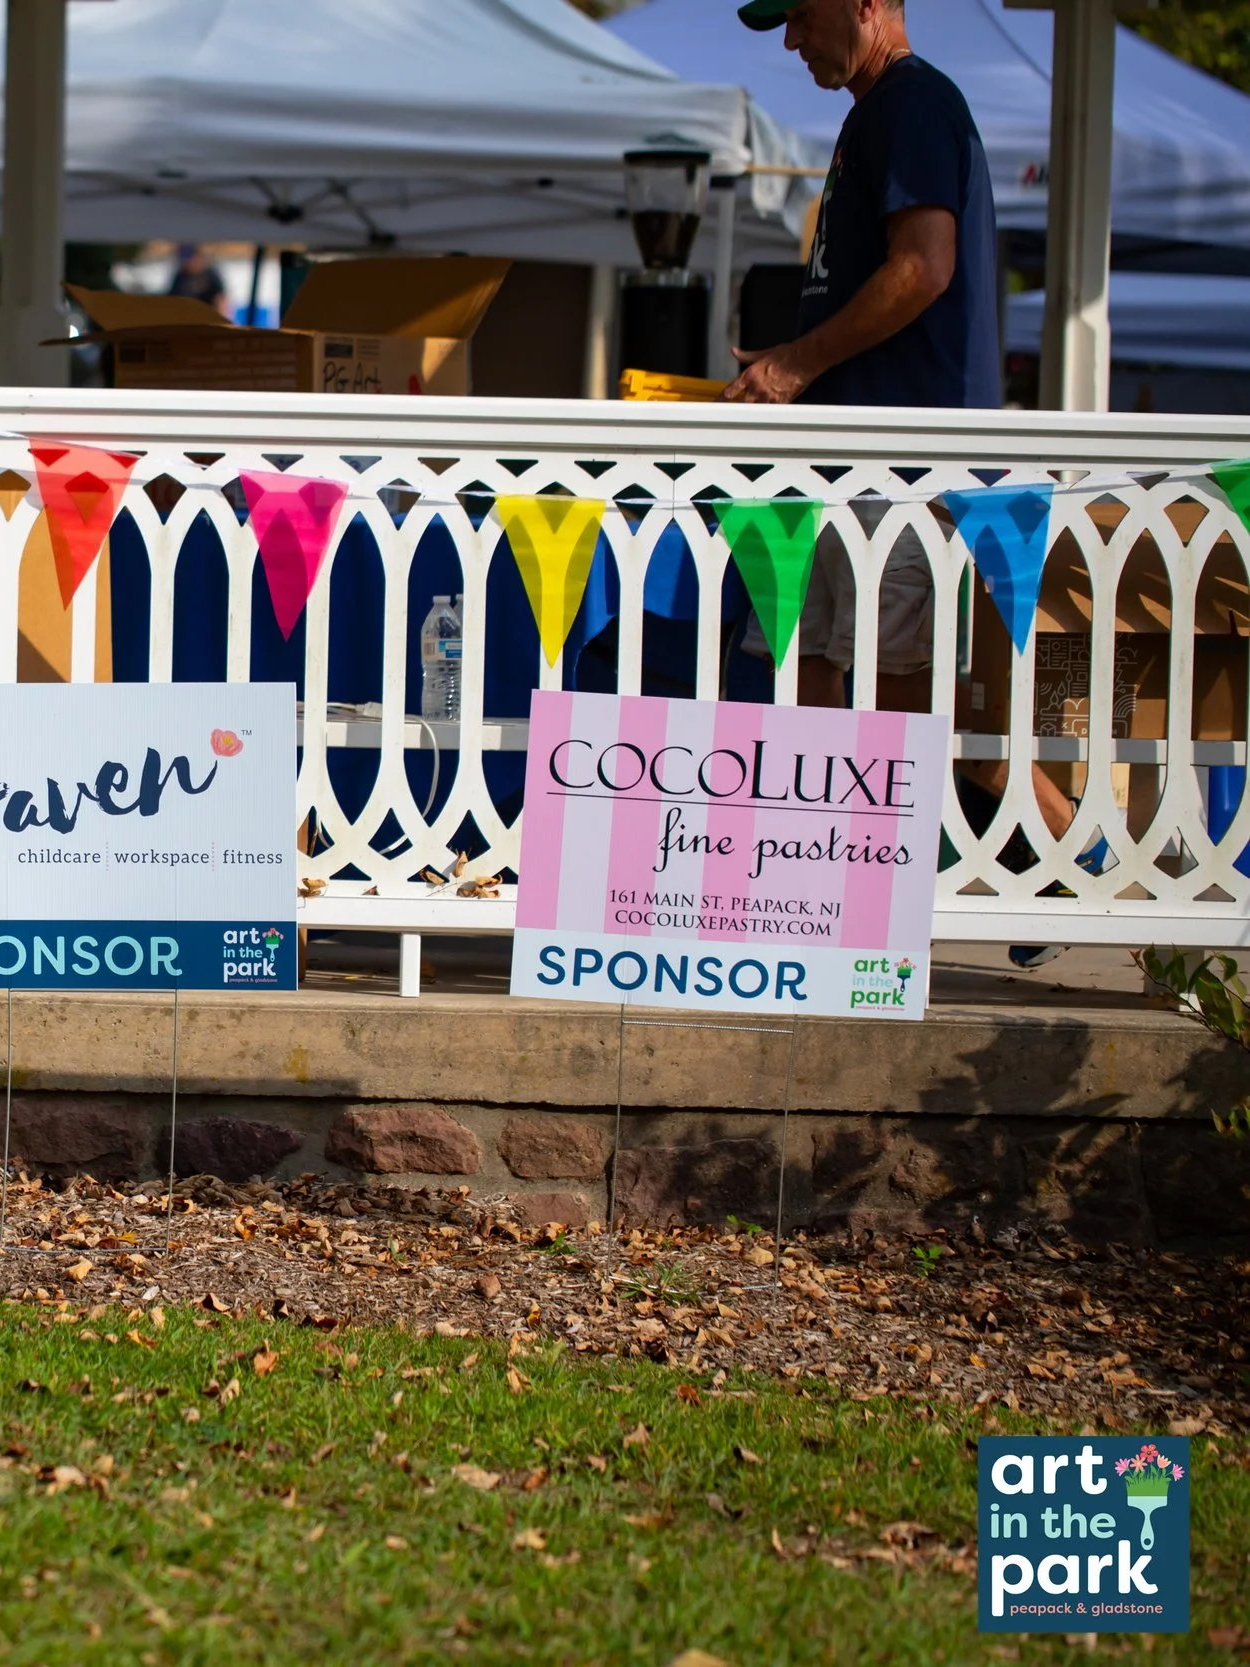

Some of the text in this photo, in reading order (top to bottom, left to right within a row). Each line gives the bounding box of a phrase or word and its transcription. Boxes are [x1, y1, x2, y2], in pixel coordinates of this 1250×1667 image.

[323, 362, 348, 392] PG
[652, 807, 913, 879] fine pastries
[18, 849, 283, 867] childcare workspace fitness
[610, 889, 637, 904] 161
[643, 891, 695, 908] MAIN
[731, 896, 814, 916] PEAPACK,
[820, 902, 842, 920] NJ
[615, 909, 832, 937] COCOLUXEPASTRY.COM
[223, 927, 261, 945] art
[223, 946, 263, 959] in the
[223, 957, 277, 983] park
[537, 945, 808, 1001] SPONSOR
[854, 957, 890, 974] art
[852, 974, 893, 988] in the
[850, 987, 905, 1009] park
